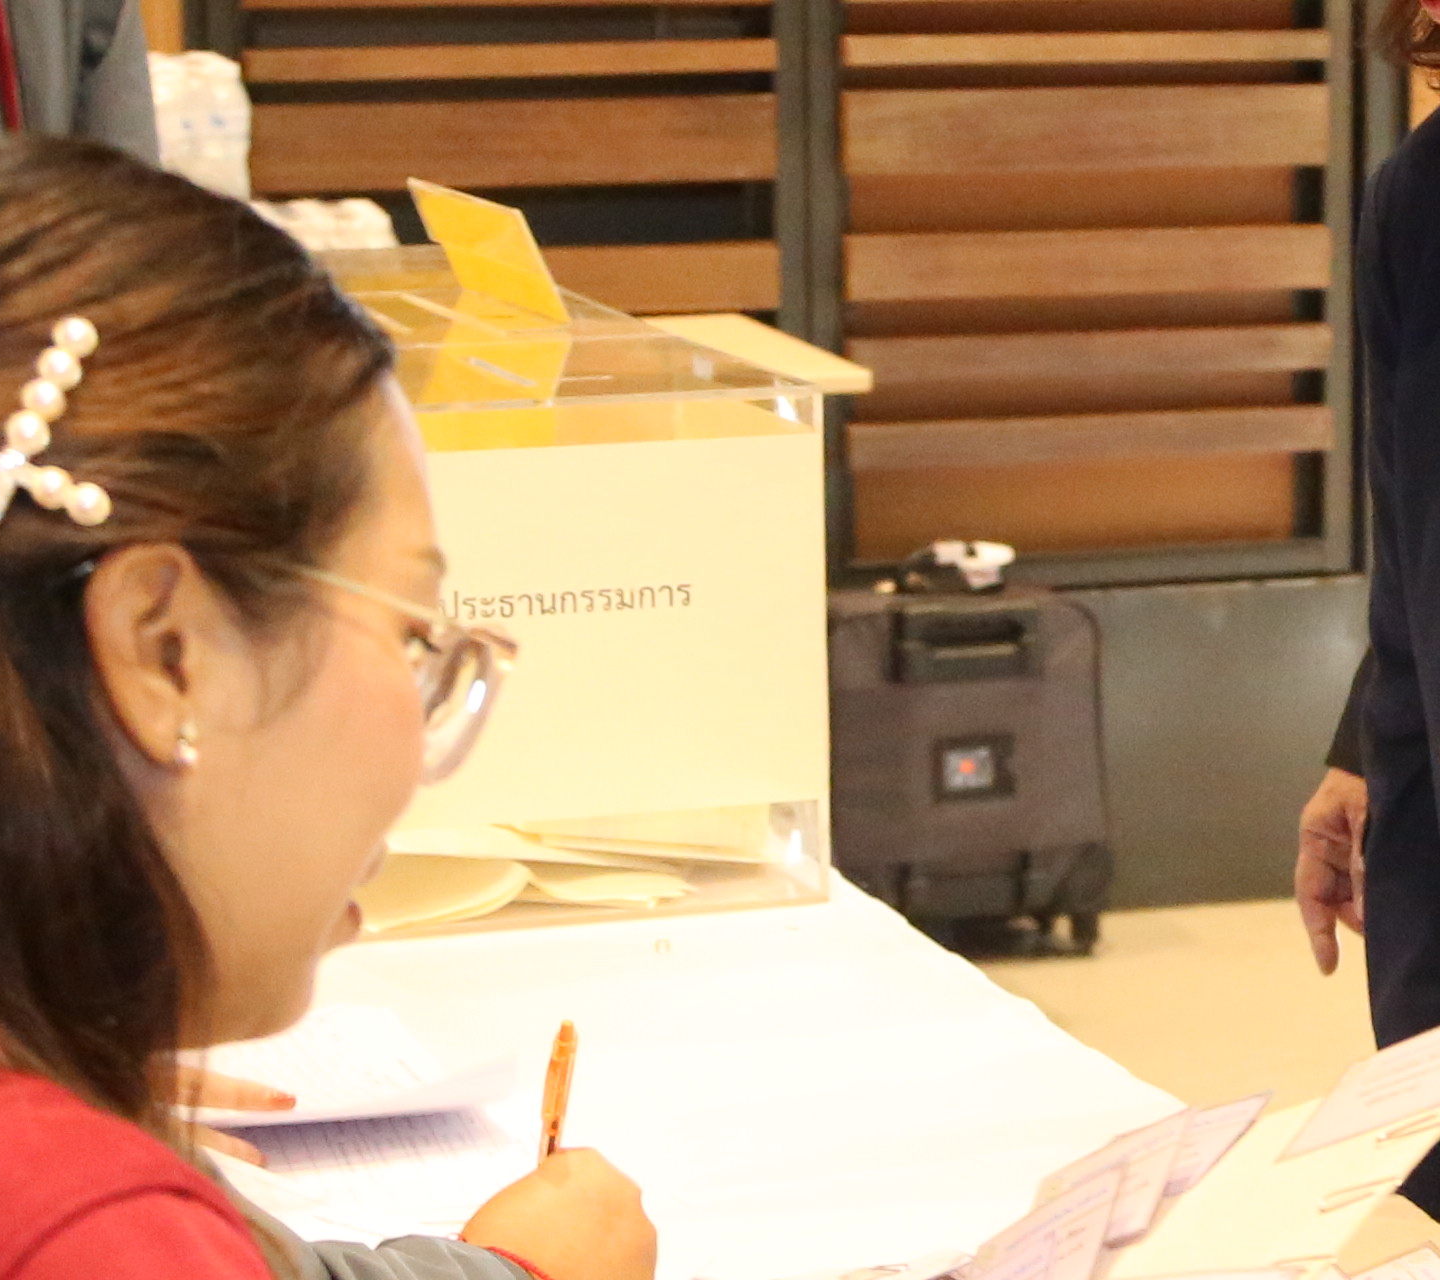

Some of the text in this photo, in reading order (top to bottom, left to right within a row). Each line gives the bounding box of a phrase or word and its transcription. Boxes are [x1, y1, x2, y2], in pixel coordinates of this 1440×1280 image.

[440, 583, 693, 620] ประธานกรรมการ
